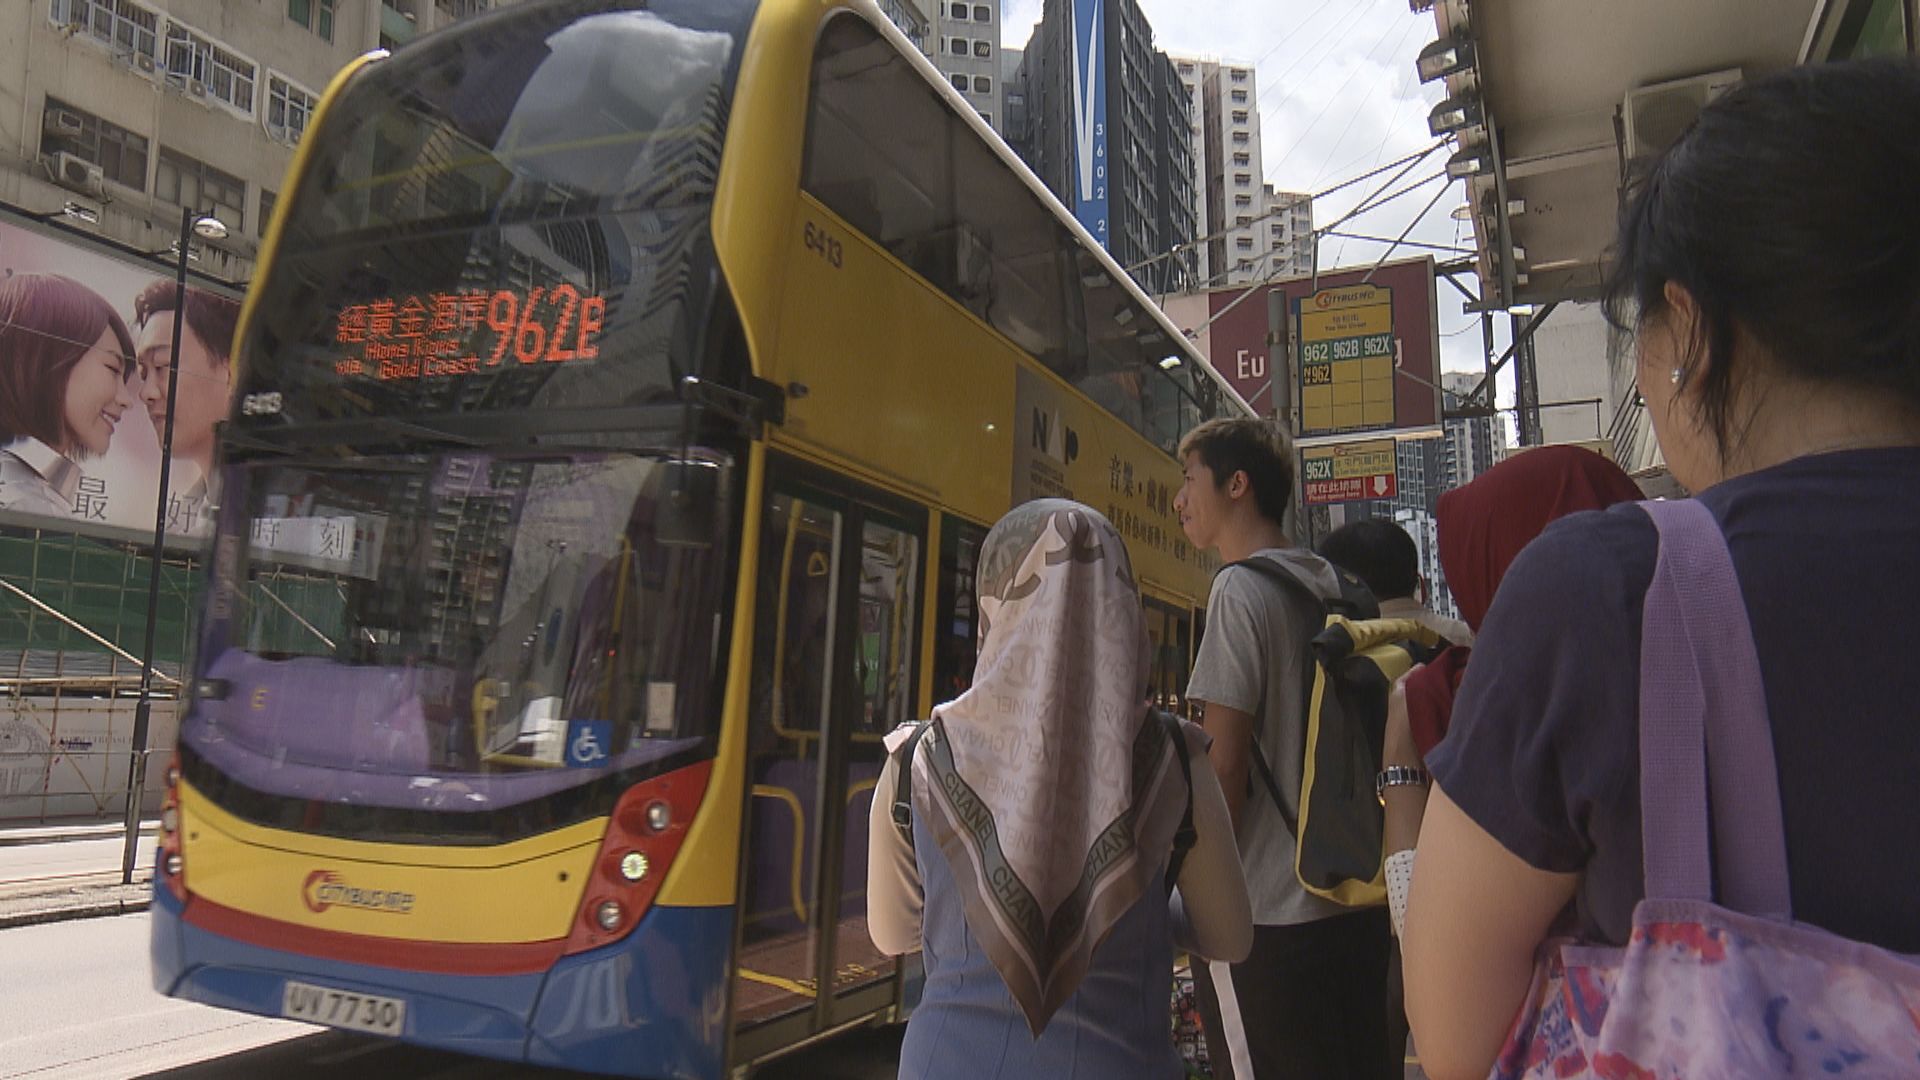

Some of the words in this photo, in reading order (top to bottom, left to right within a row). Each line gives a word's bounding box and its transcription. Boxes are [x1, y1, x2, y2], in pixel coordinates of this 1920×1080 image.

[804, 220, 843, 269] 6413
[1236, 349, 1265, 379] Eu
[1304, 343, 1328, 361] 962
[1333, 339, 1359, 359] 962B
[1364, 336, 1390, 356] 962X
[1306, 460, 1331, 480] 962X
[944, 771, 993, 849] CHANEL
[328, 993, 398, 1029] 7730
